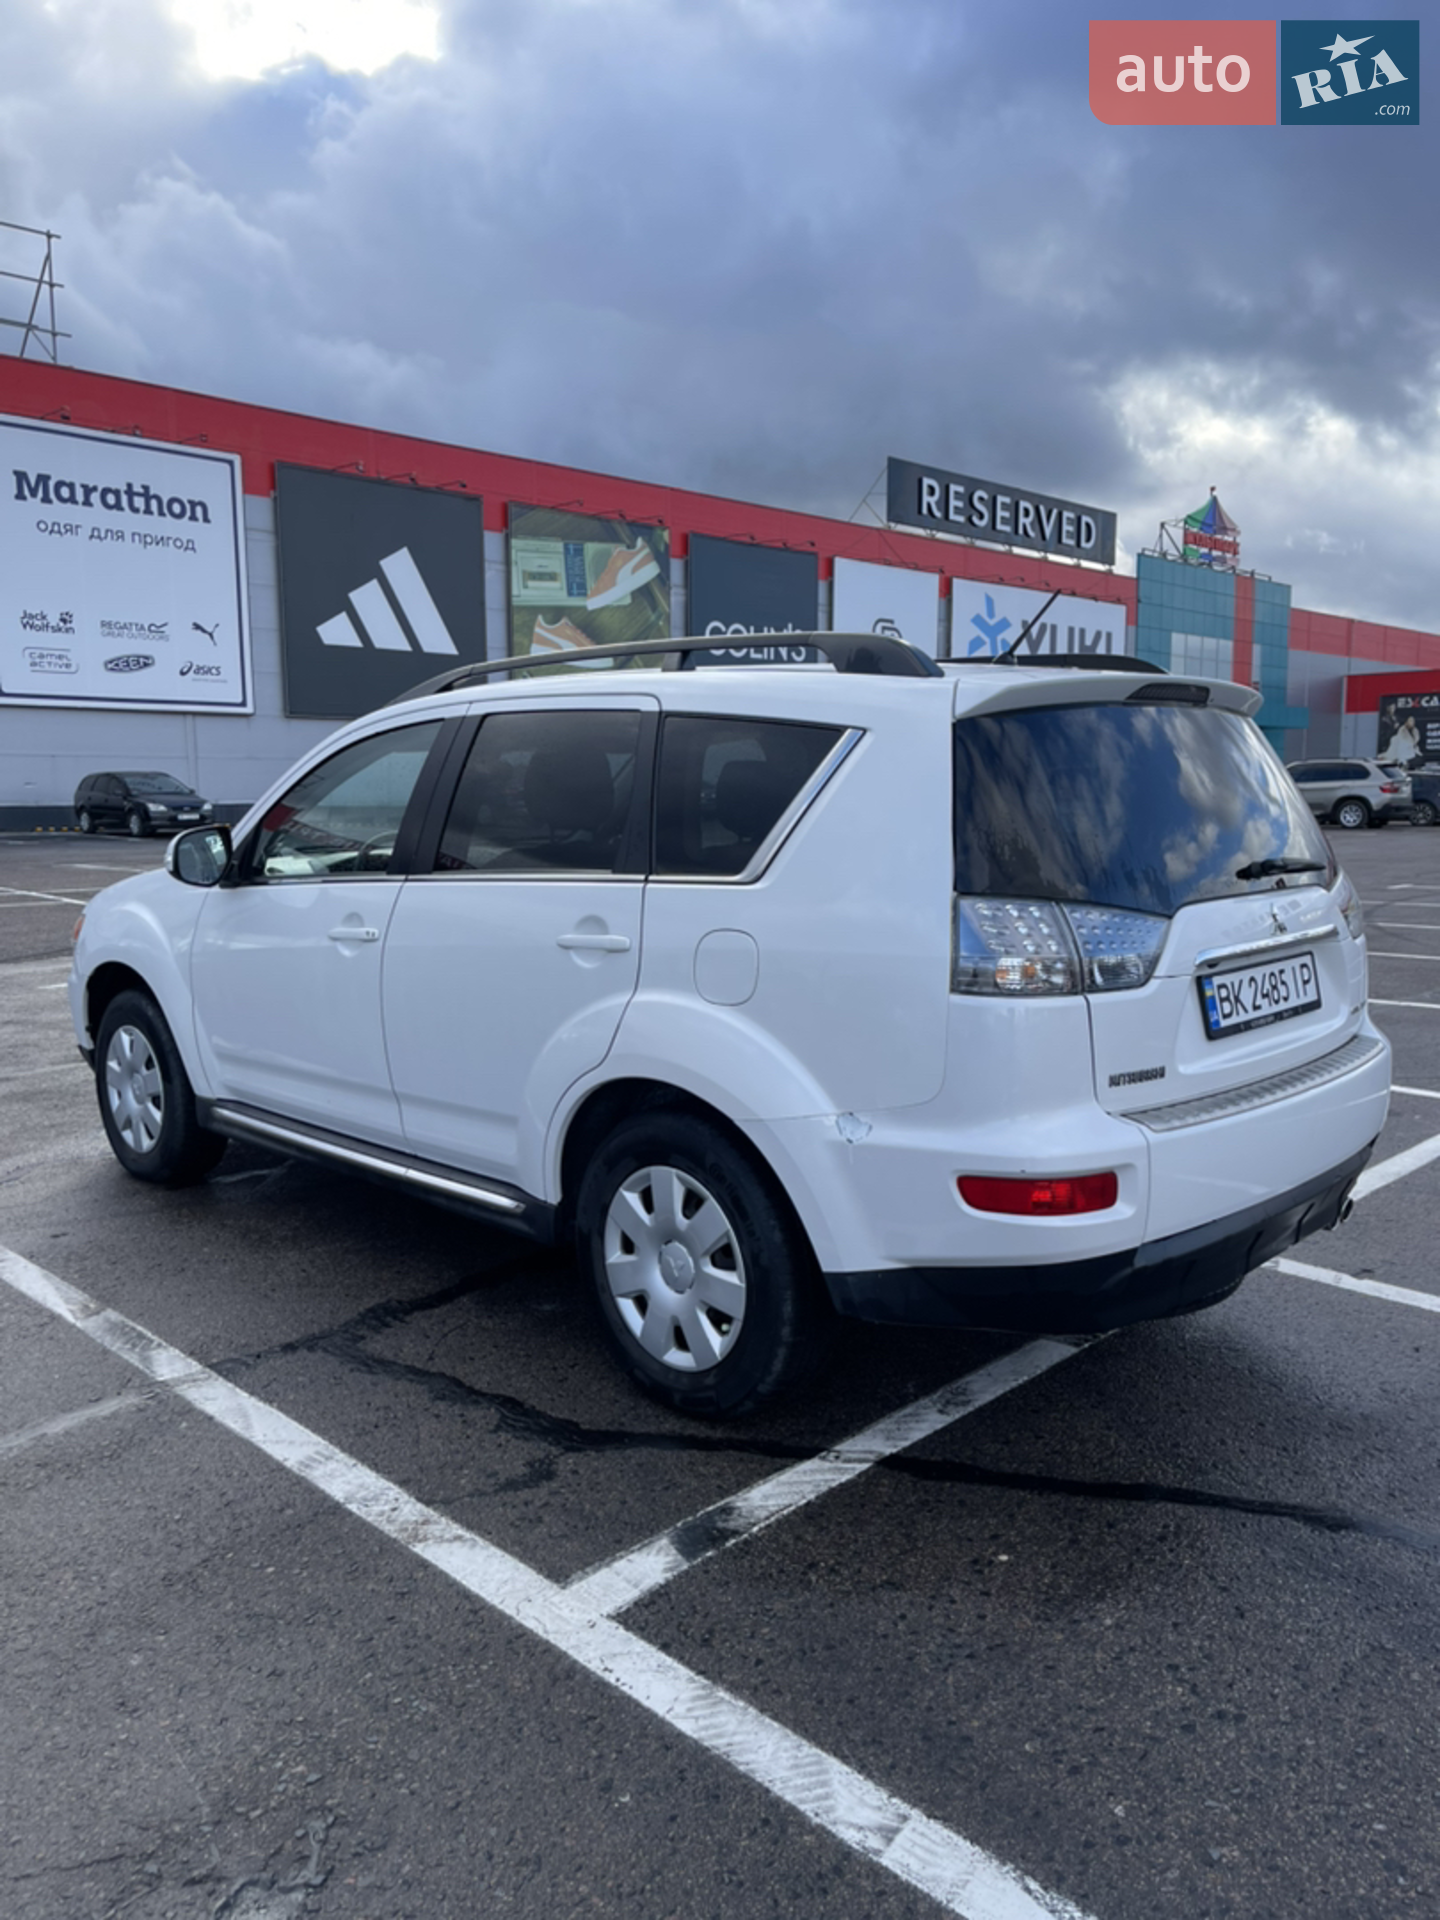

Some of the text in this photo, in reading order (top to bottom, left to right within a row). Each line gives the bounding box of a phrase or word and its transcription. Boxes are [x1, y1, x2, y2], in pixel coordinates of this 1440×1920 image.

[12, 469, 212, 524] Marathon
[919, 475, 1097, 550] RESERVED
[36, 519, 197, 554] одяг для пригод
[20, 609, 49, 621] Jack
[20, 619, 76, 635] Wolfskin
[100, 620, 147, 632] REGATTA
[105, 656, 154, 671] KEEN
[193, 664, 221, 676] asics
[1216, 979, 1249, 1019] BK
[1248, 968, 1290, 1012] 2485
[1291, 962, 1312, 1000] IP
